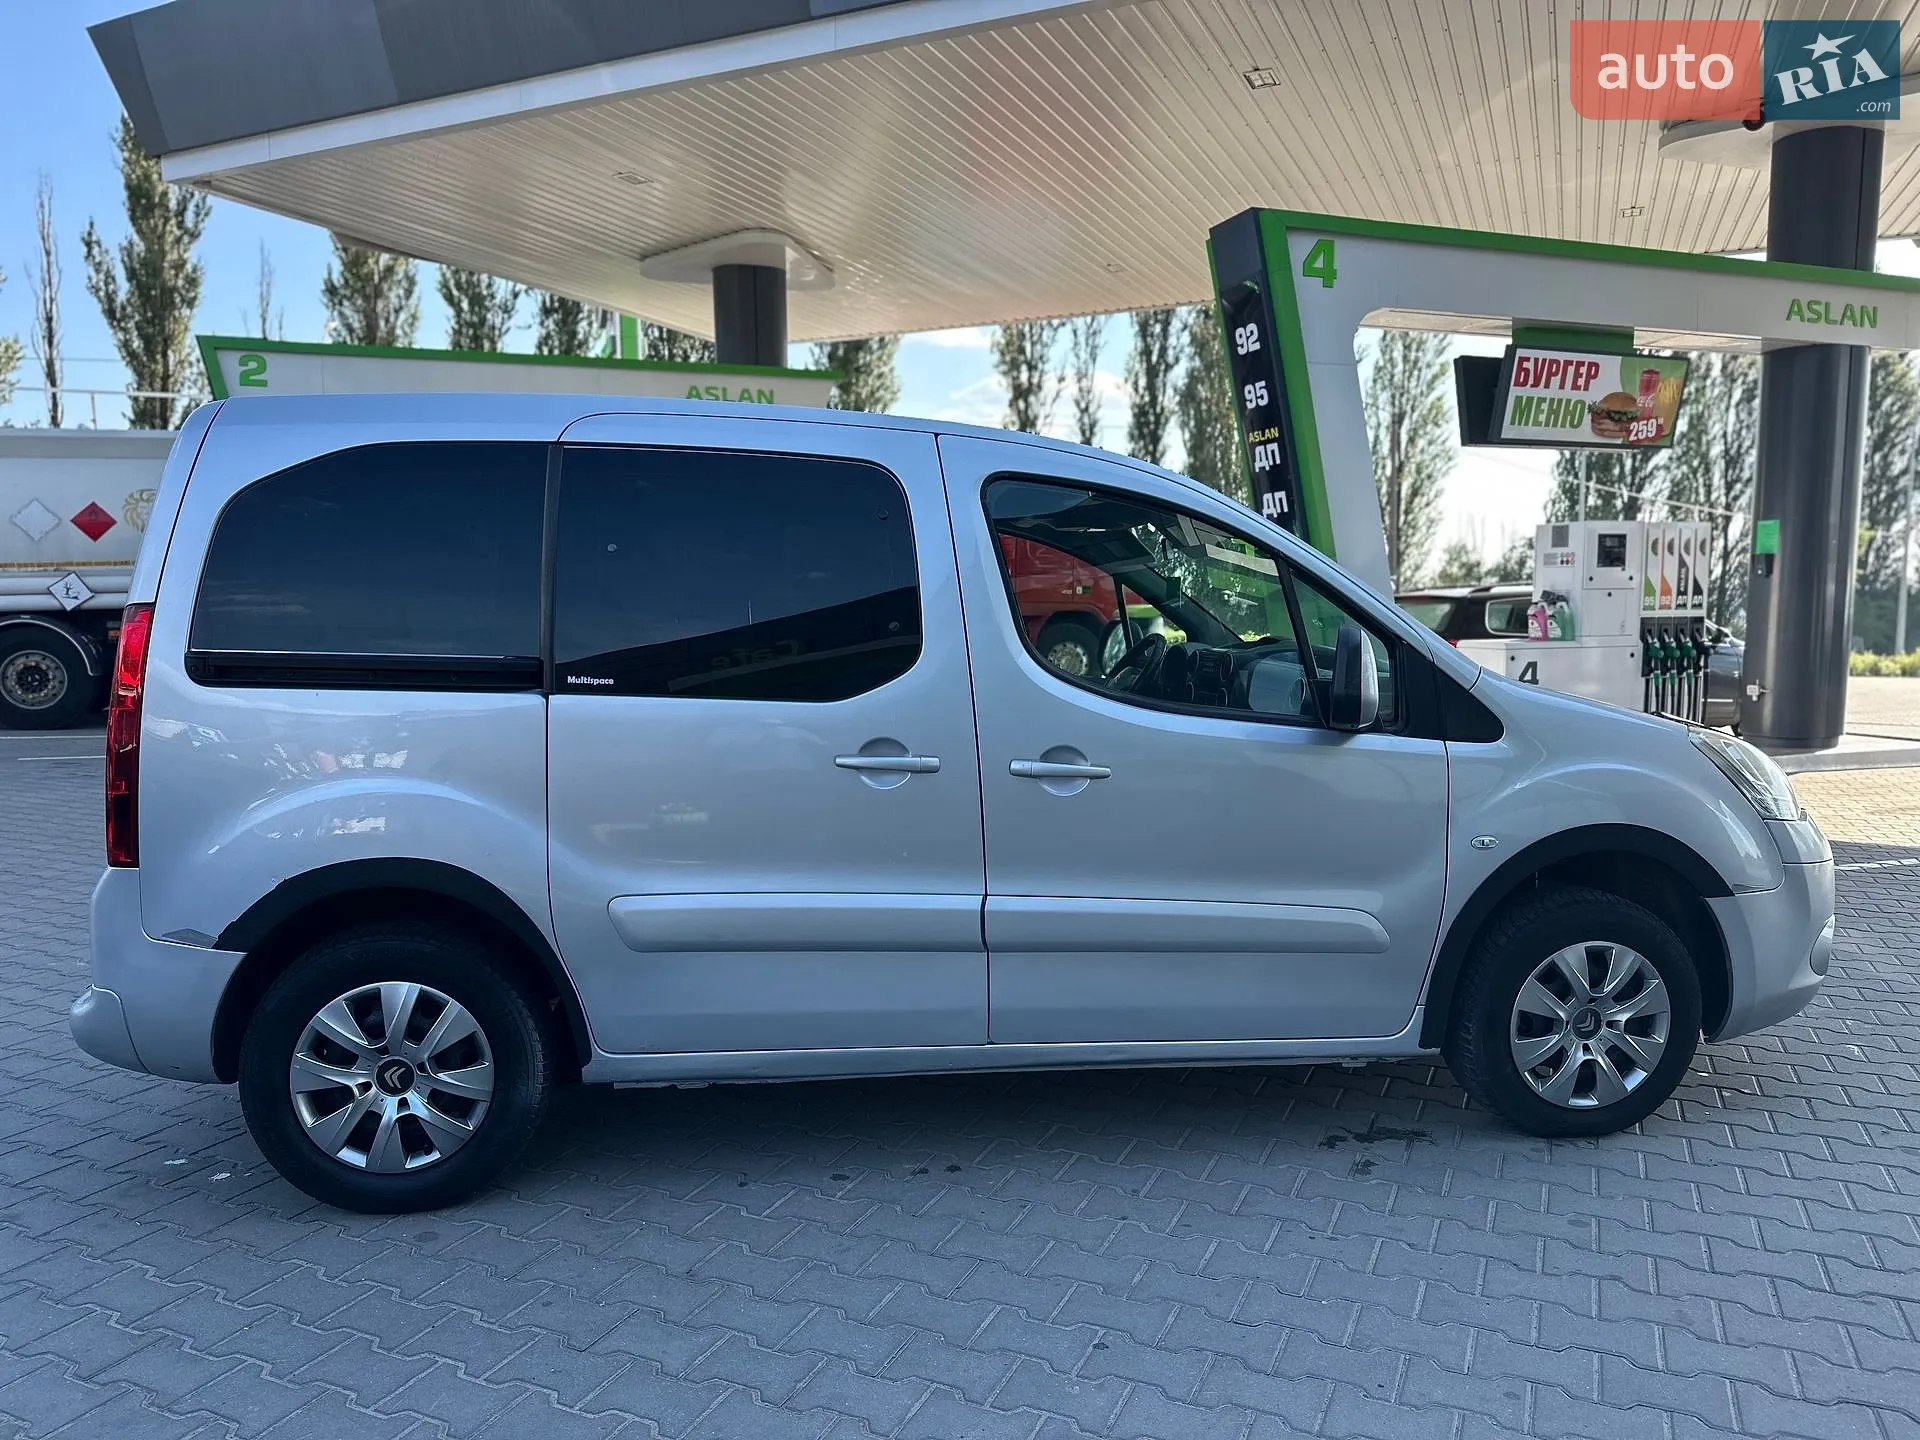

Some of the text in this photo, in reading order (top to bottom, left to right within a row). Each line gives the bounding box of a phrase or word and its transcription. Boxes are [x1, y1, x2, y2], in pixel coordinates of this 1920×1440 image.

[1302, 238, 1337, 288] 4
[1786, 298, 1878, 329] ASLAN
[1235, 322, 1261, 356] 92
[238, 353, 268, 388] 2
[1512, 355, 1600, 392] БУРГЕР
[686, 384, 775, 405] ASLAN
[1243, 380, 1269, 409] 95
[1509, 395, 1587, 430] МЕНЮ
[1248, 426, 1280, 443] ASLAN
[1628, 420, 1657, 442] 259
[1254, 442, 1281, 473] ДП
[1261, 490, 1289, 519] ДП
[567, 675, 615, 686] Multispace
[1518, 660, 1540, 685] 4
